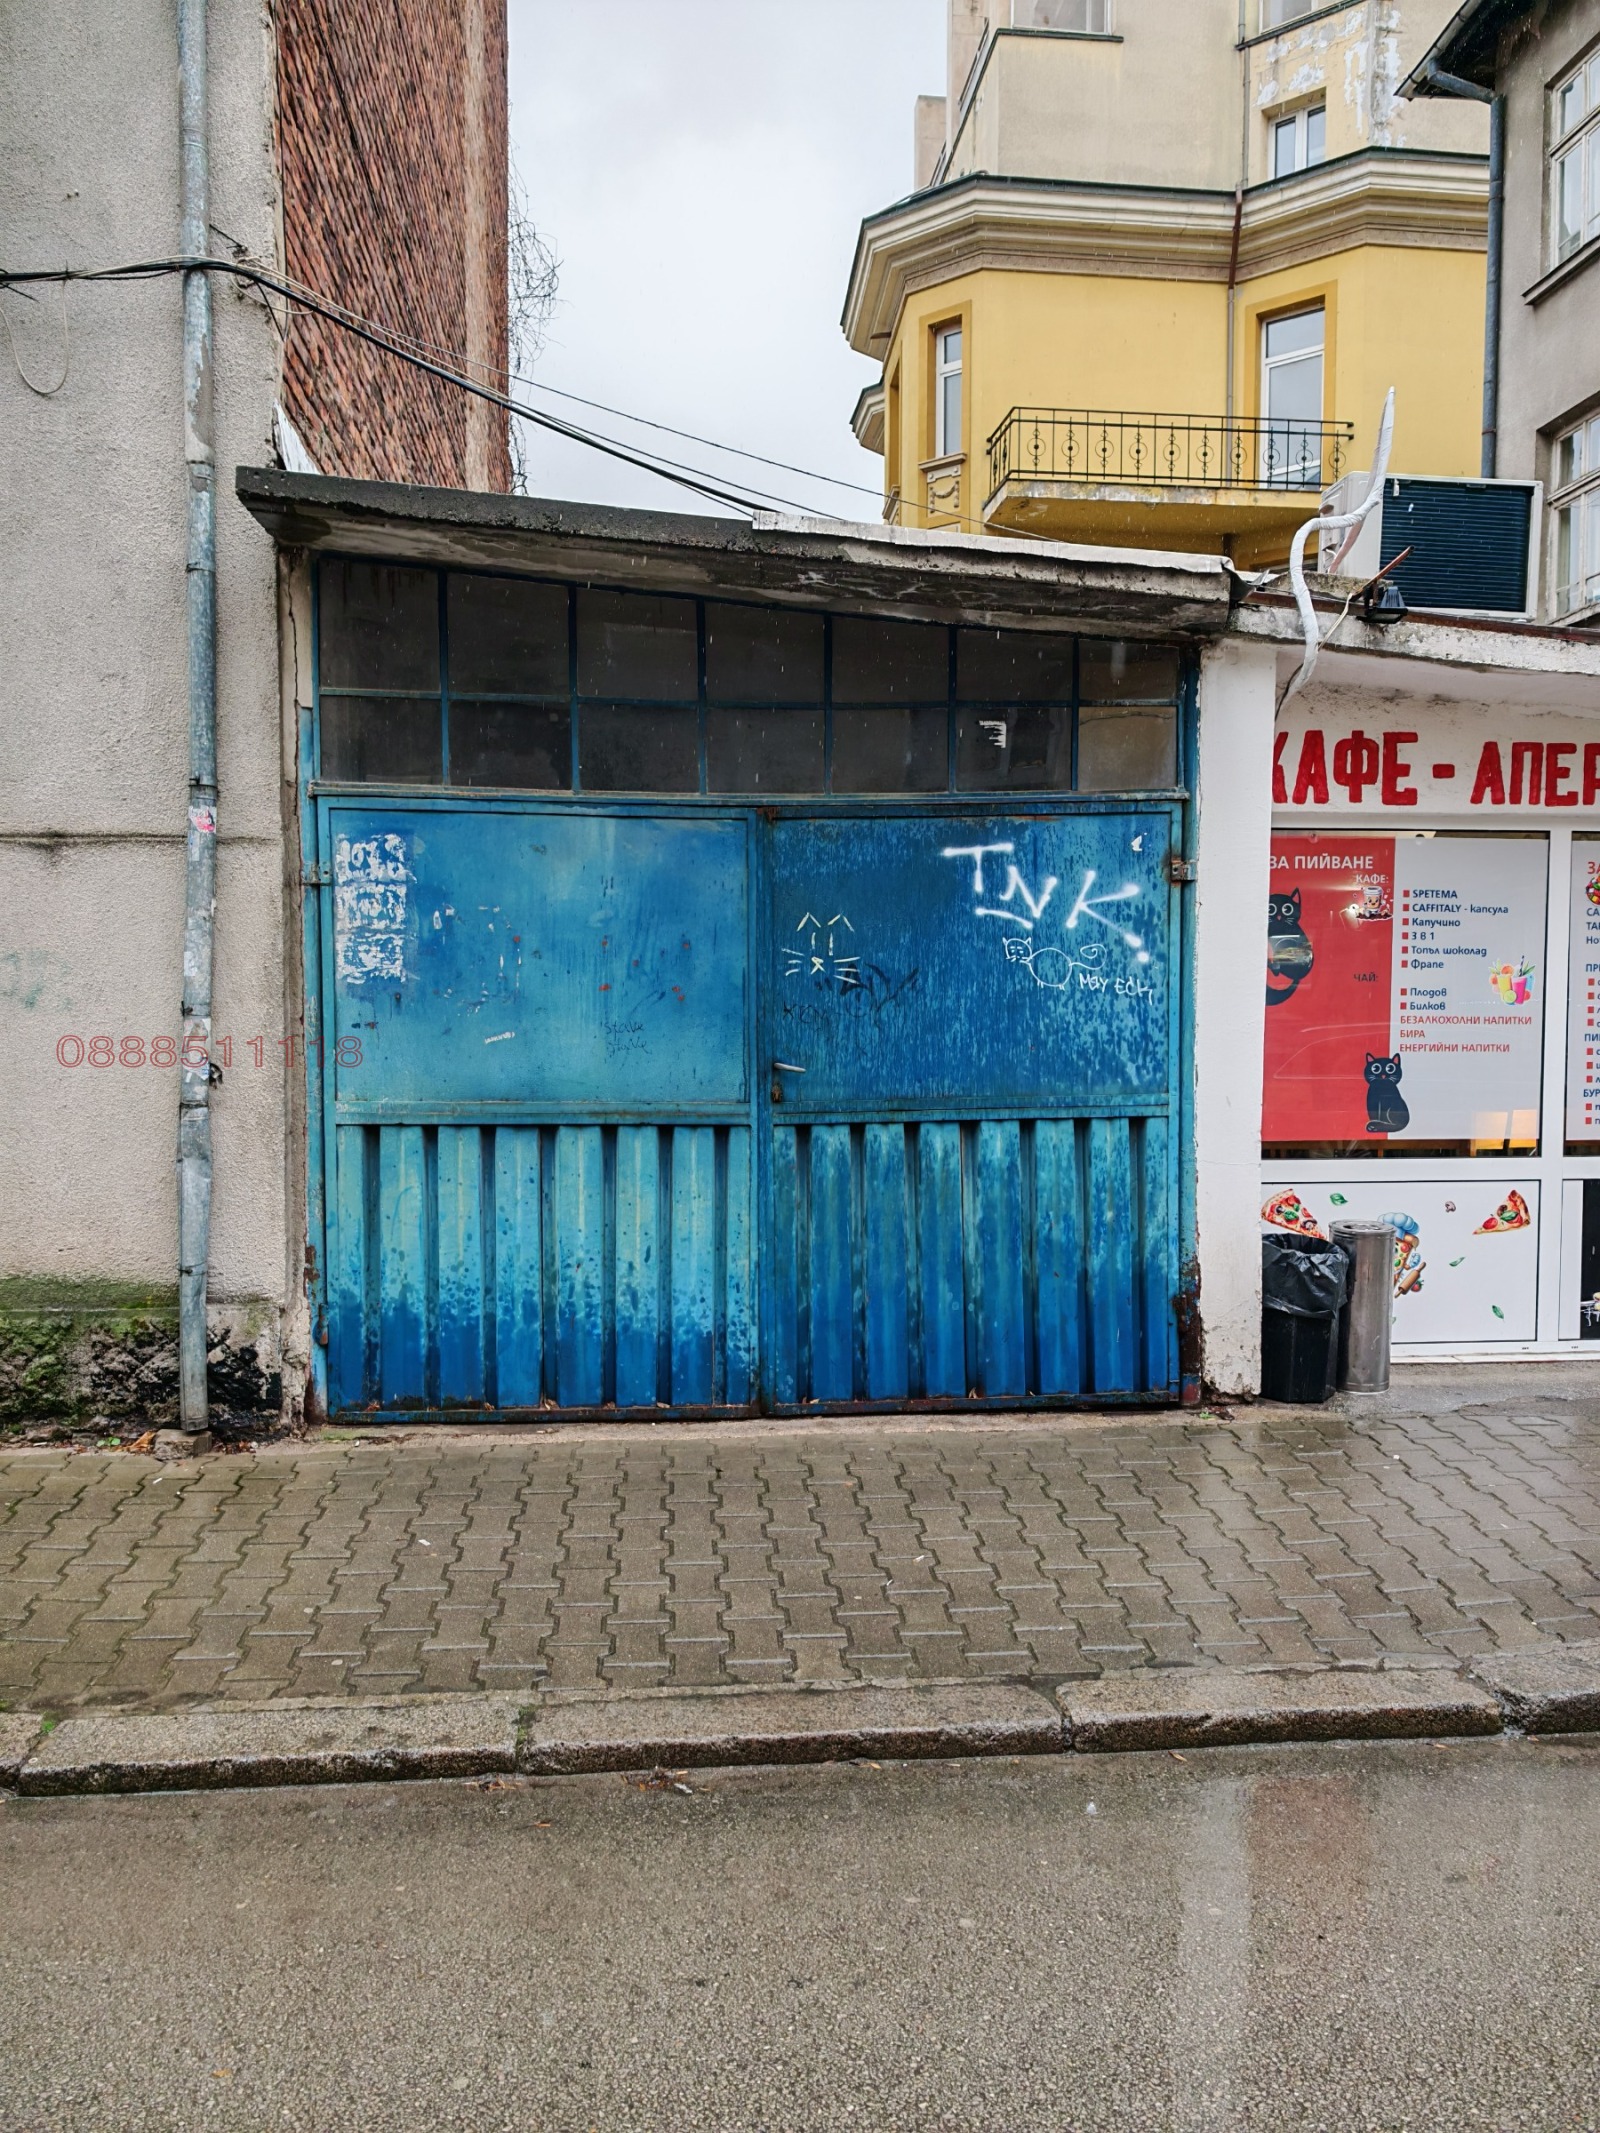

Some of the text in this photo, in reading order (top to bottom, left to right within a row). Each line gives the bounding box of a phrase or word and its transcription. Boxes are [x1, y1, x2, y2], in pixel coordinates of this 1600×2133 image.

[1294, 852, 1374, 869] ПИЙВАНЕ
[1356, 873, 1389, 884] КАФЕ:
[1412, 889, 1458, 899] SPETEMA
[1412, 903, 1462, 913] CAFFITALY
[1470, 904, 1509, 916] капсула
[1411, 917, 1461, 928] Капучино
[1430, 932, 1435, 940] 1
[1411, 945, 1488, 957] Топъл шоколад
[1410, 959, 1444, 971] Фрапе
[1409, 987, 1447, 999] Плодов
[1409, 1001, 1446, 1011] Билков
[1400, 1015, 1532, 1025] БЕЗАЛКОХОЛНИ НАПИТКИ
[1399, 1029, 1425, 1038] БИРА
[1399, 1041, 1510, 1053] ЕНЕРГИЙНИ НАПИТКИ
